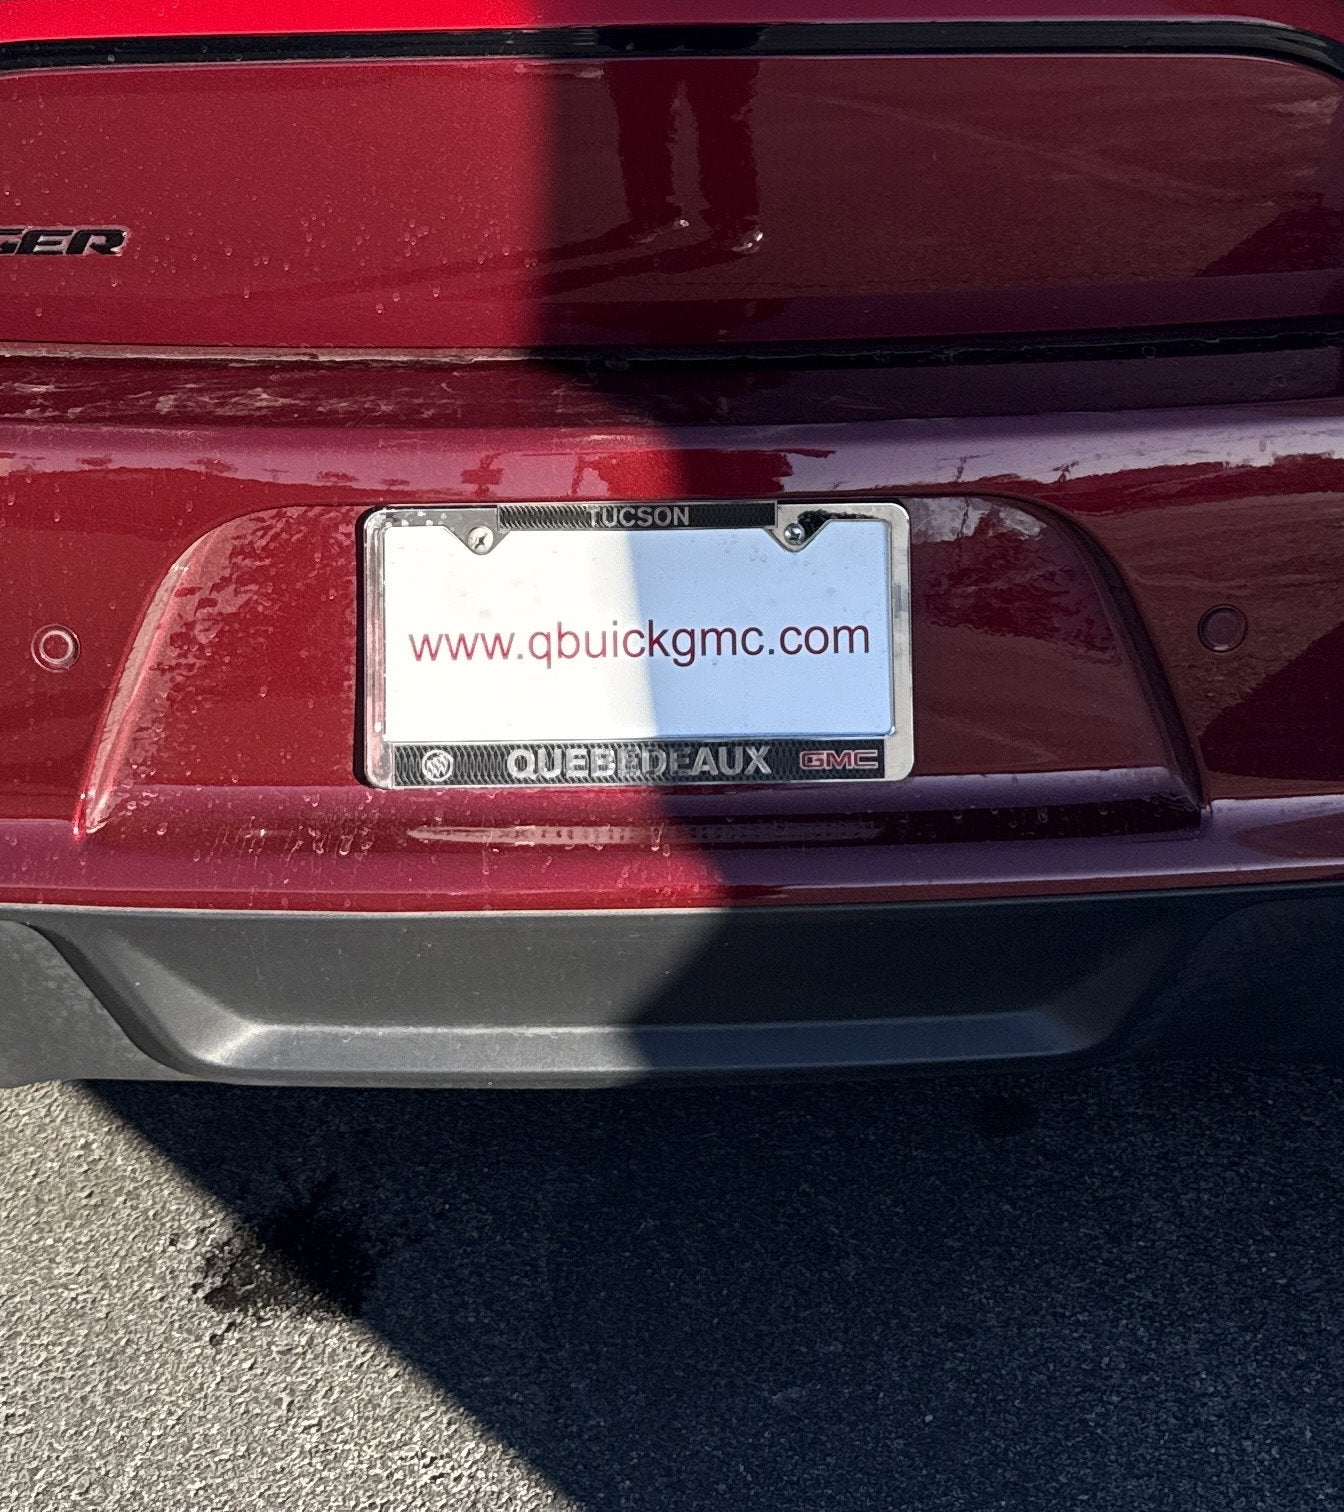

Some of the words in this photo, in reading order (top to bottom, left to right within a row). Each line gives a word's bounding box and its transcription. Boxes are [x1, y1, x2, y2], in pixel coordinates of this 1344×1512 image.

[586, 505, 691, 528] TUCSON
[408, 619, 871, 669] www.qbuickgmc.com
[507, 745, 772, 779] QUEBEDEAUX
[799, 748, 879, 770] GMC
